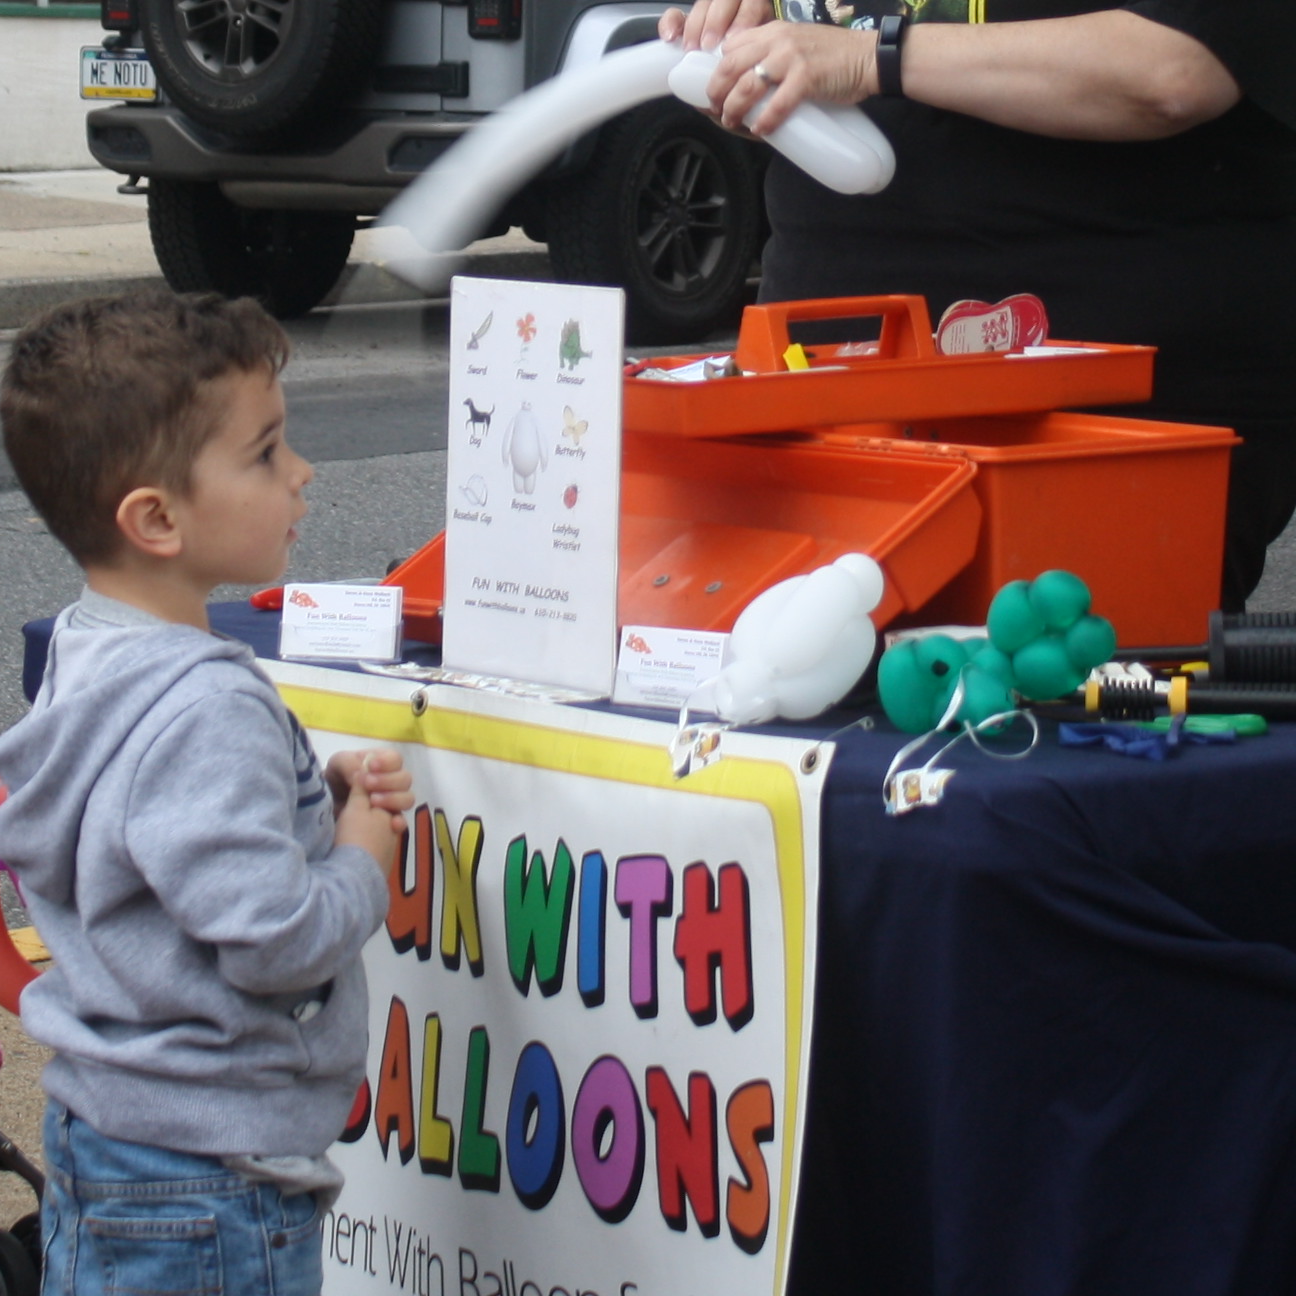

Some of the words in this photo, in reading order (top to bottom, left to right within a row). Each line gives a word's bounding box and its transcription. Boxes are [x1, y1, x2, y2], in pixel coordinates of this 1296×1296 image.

[91, 62, 107, 85] ME
[114, 62, 147, 86] NOTU
[467, 364, 487, 375] Sword
[516, 368, 538, 380] Flower
[556, 373, 585, 385] Dinosaur
[469, 435, 482, 448] Dog
[555, 445, 586, 461] Butterfly
[453, 509, 479, 521] Baseball
[480, 512, 492, 524] Cap
[552, 523, 580, 538] Ladybug
[472, 577, 491, 590] FUN
[496, 580, 520, 595] WITH
[525, 584, 569, 602] BALLOONS
[385, 802, 485, 978] UN
[504, 832, 754, 1032] WITH
[338, 995, 775, 1255] ALLOONS
[384, 1214, 444, 1296] With
